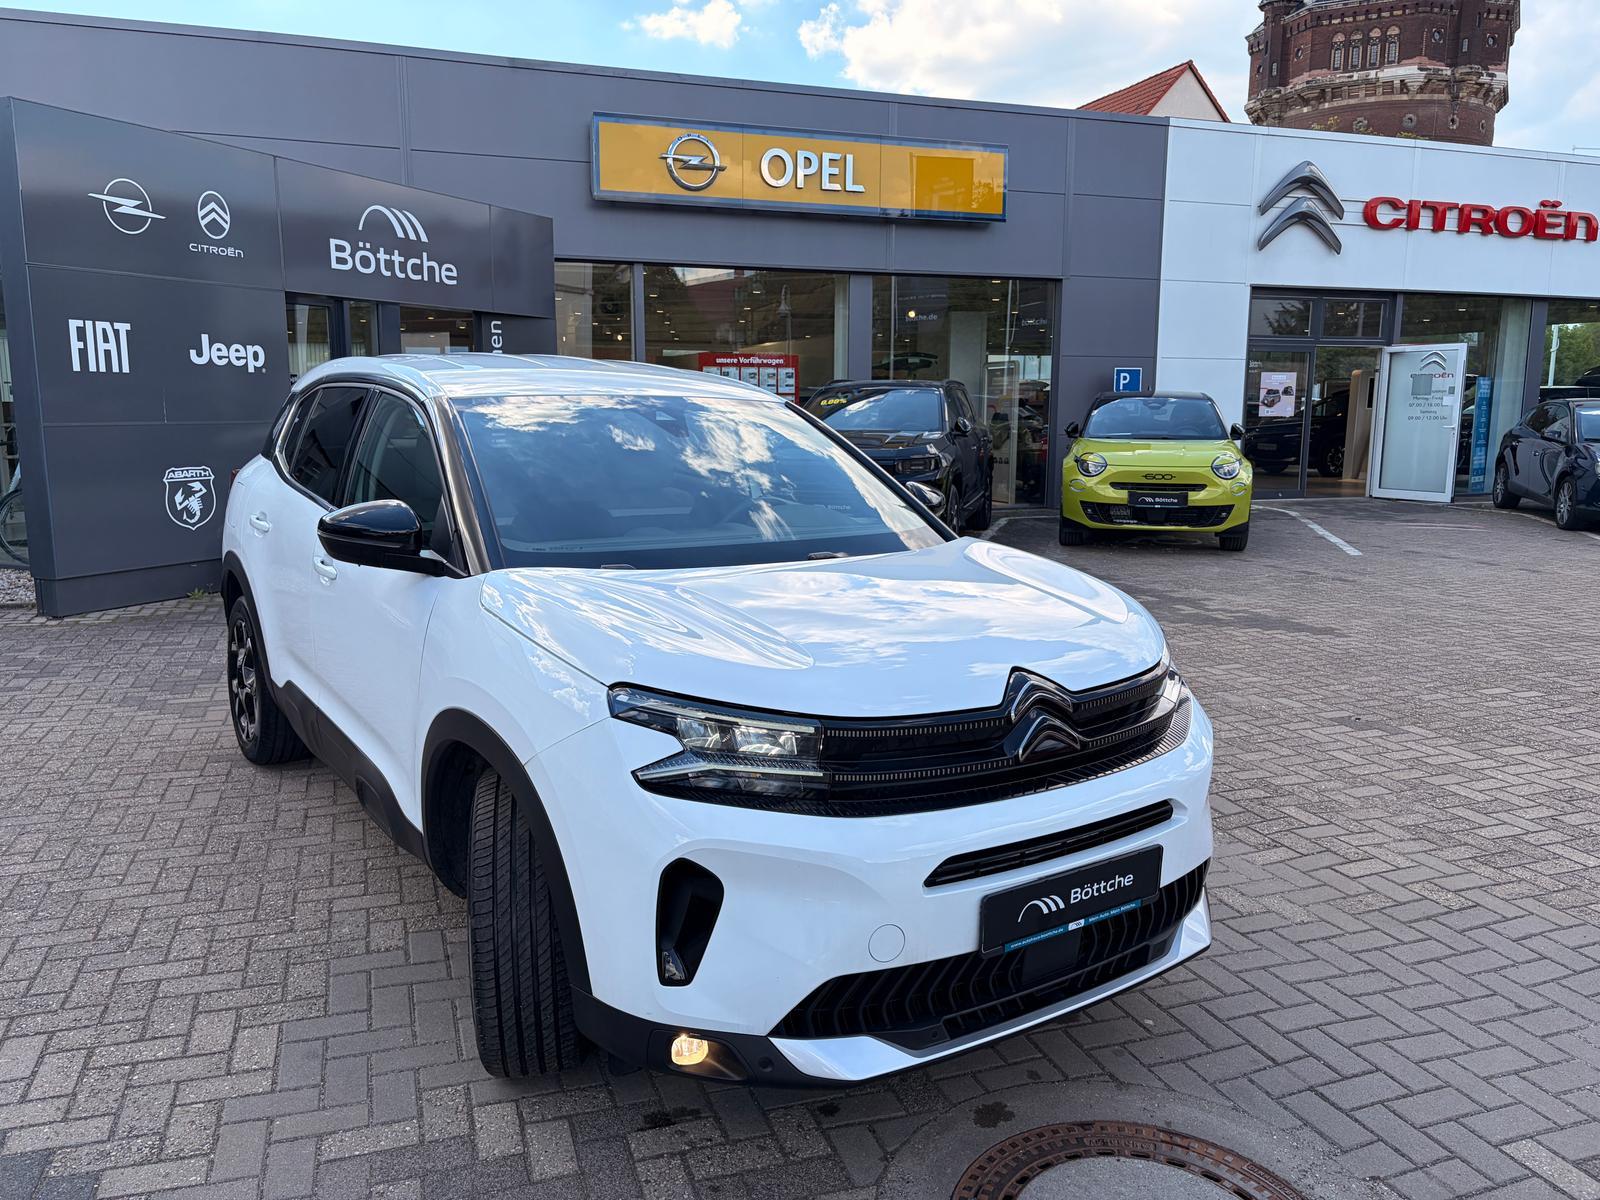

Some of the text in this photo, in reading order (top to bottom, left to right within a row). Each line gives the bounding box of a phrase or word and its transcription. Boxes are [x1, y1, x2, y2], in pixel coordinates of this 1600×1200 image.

[760, 147, 865, 192] OPEL
[329, 237, 458, 285] Böttche
[68, 319, 131, 374] FIAT
[189, 334, 265, 373] Jeep
[739, 357, 784, 366] Vorführwagen
[1119, 372, 1130, 390] P
[167, 470, 209, 479] ABARTH
[1070, 874, 1134, 904] Böttche
